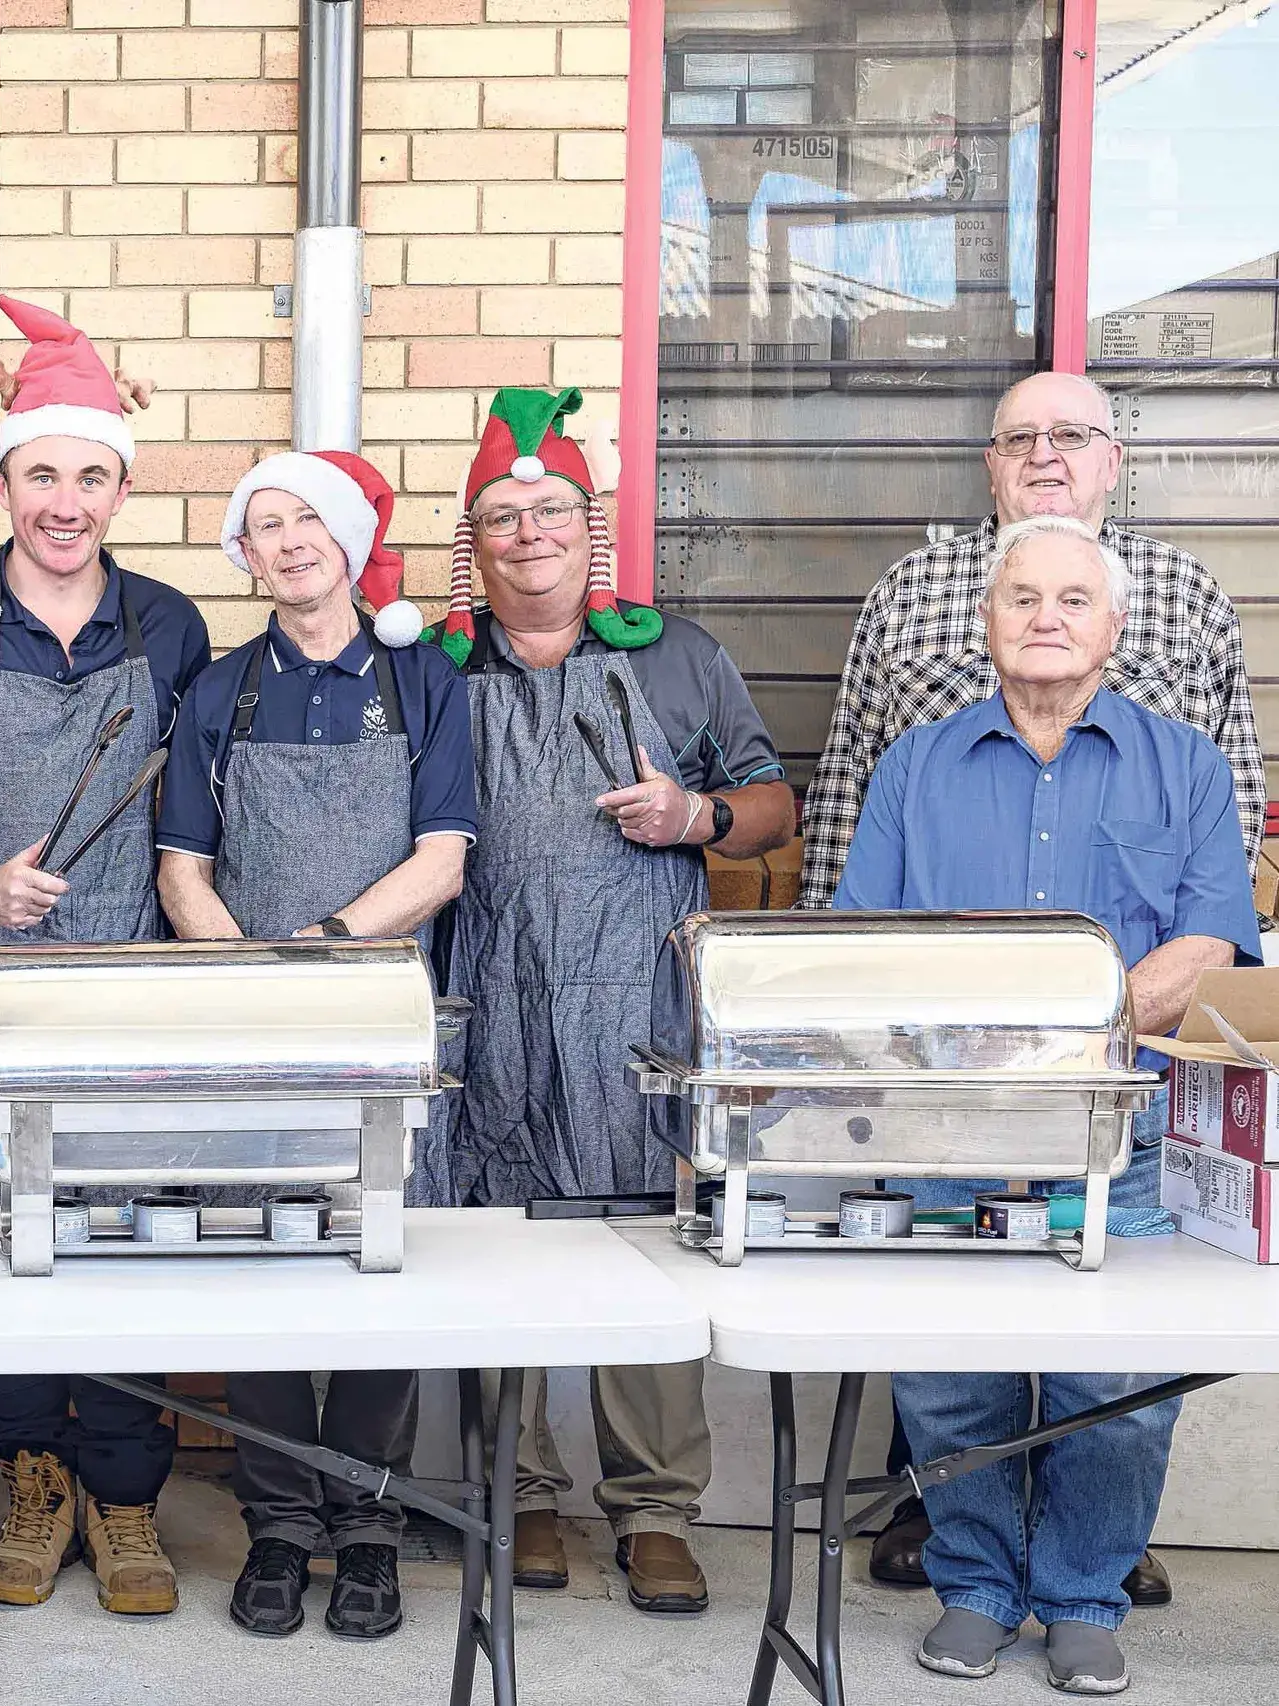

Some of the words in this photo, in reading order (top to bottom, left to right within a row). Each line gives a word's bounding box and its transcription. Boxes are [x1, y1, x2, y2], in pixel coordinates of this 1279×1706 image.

[752, 137, 801, 157] 4715
[806, 137, 830, 157] 05
[960, 237, 972, 246] 12
[975, 237, 994, 246] PCS
[980, 253, 999, 262] KGS
[979, 269, 999, 278] KGS
[360, 728, 388, 739] Oran
[1177, 1058, 1186, 1125] MasterFoo
[1191, 1061, 1200, 1133] BARBECU
